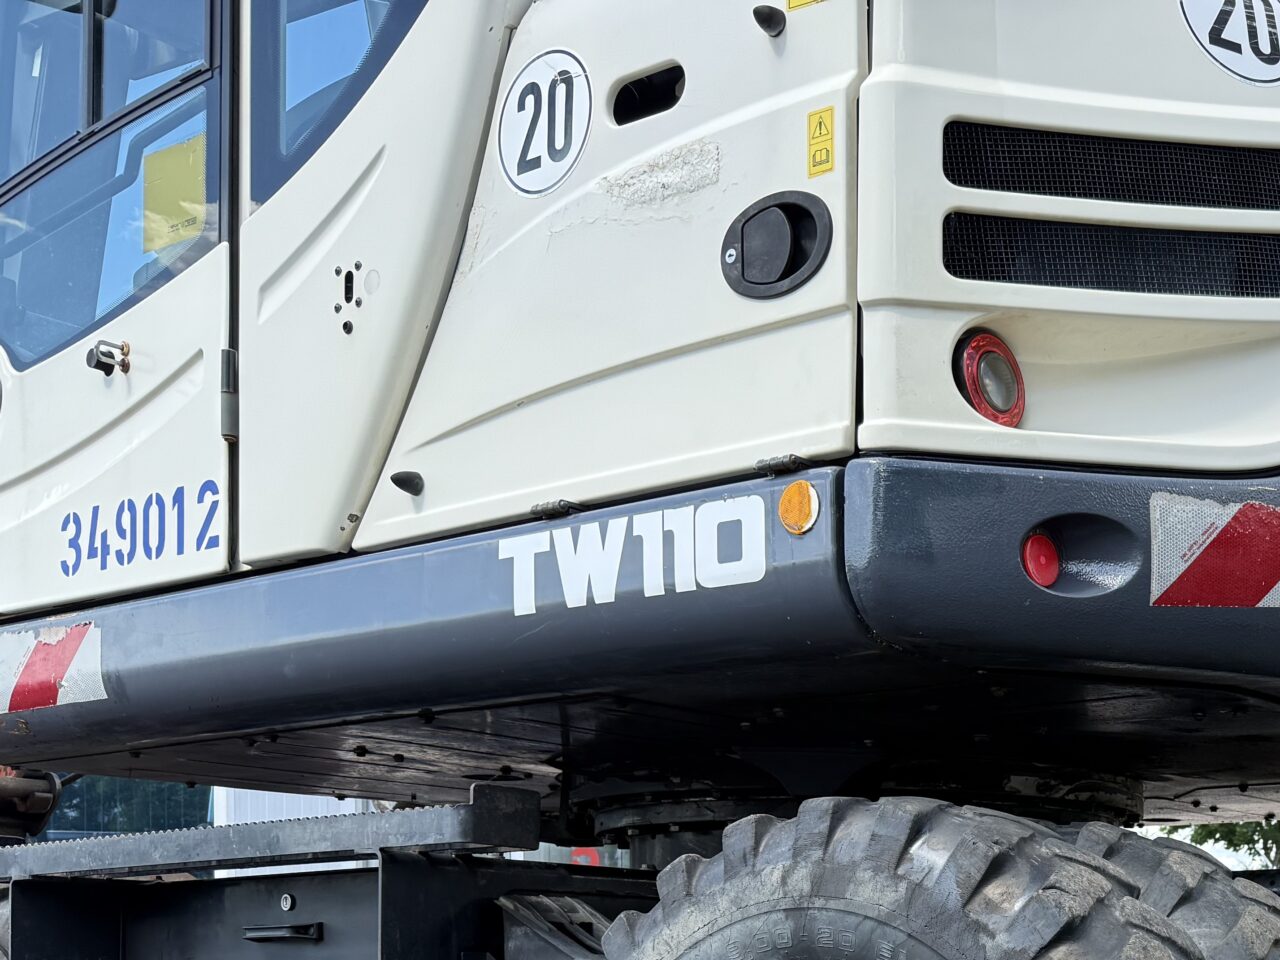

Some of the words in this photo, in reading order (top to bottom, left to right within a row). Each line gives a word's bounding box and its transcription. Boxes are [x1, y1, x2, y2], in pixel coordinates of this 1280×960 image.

[1208, 0, 1280, 66] 20
[516, 69, 574, 176] 20
[60, 479, 220, 577] 349012
[498, 494, 766, 617] TW110
